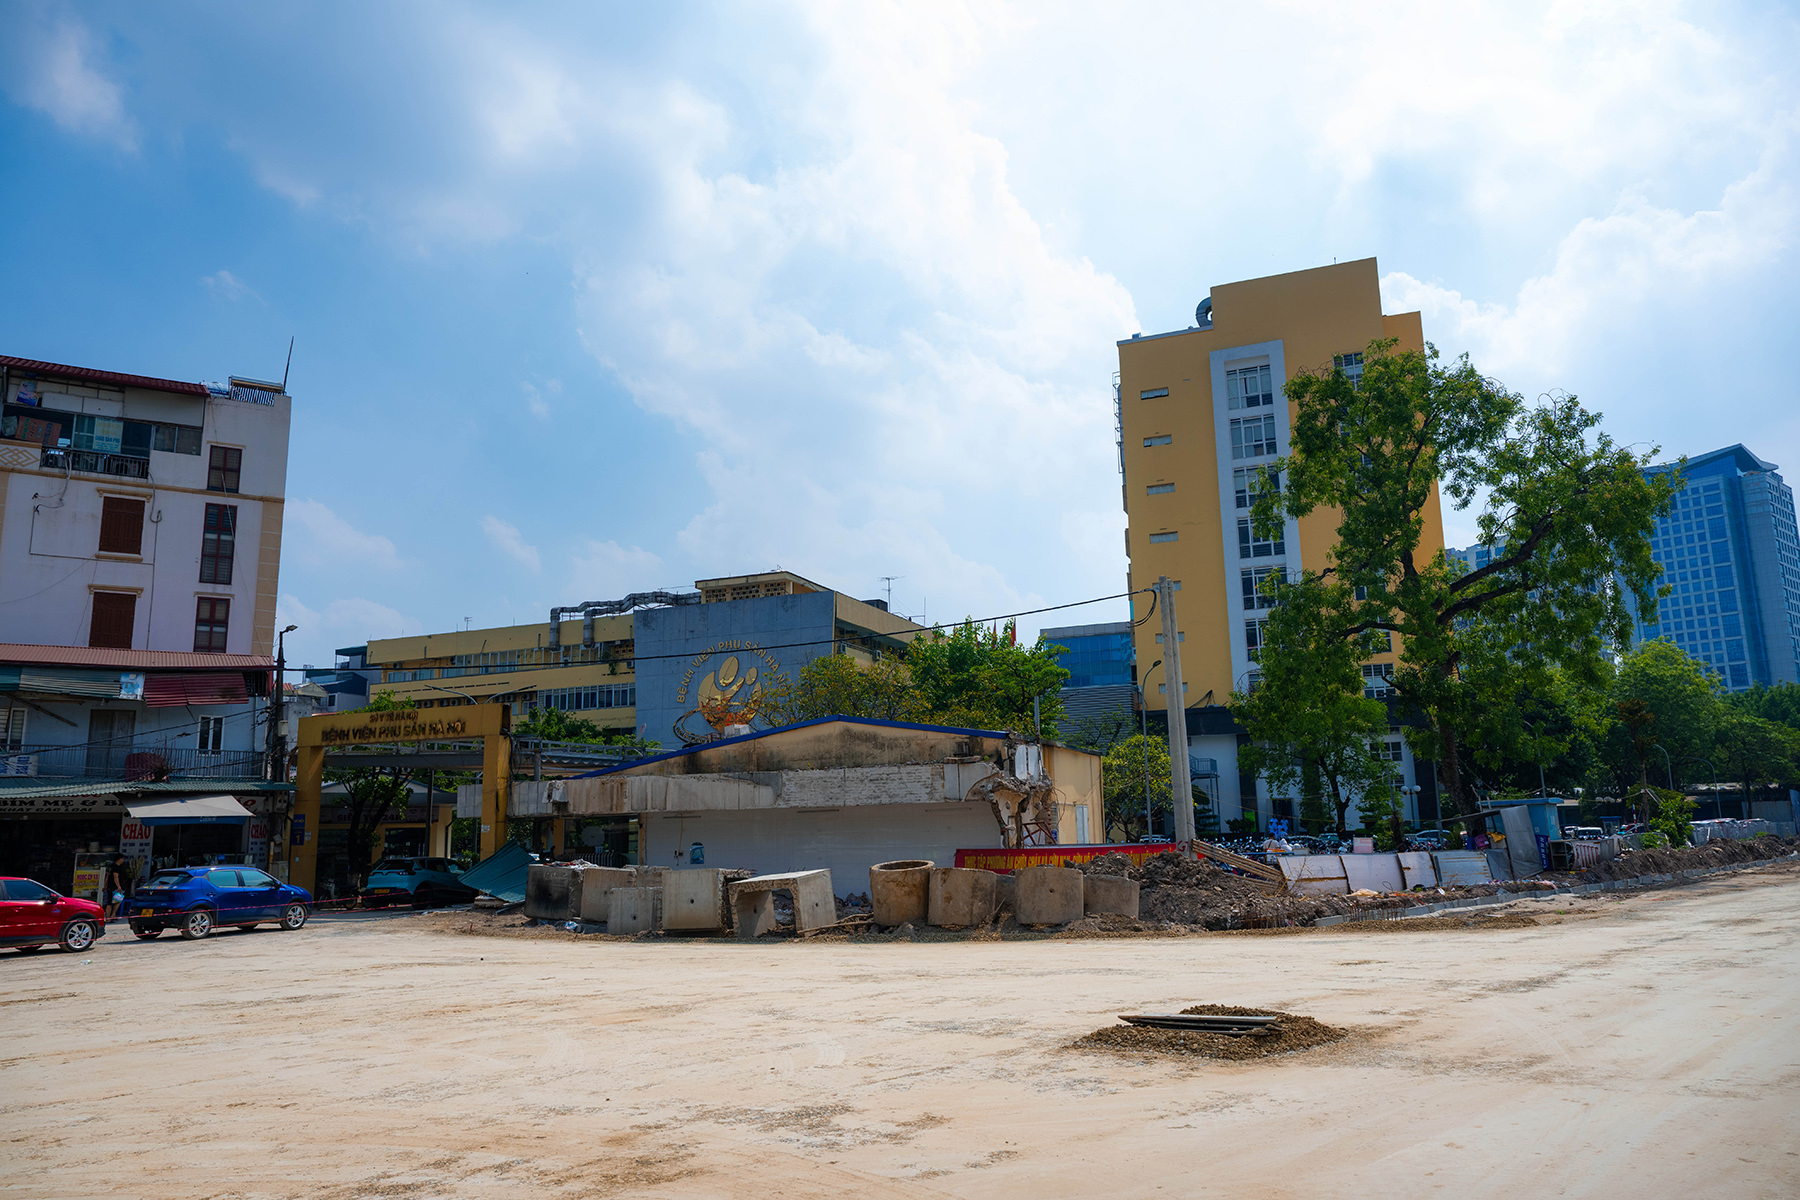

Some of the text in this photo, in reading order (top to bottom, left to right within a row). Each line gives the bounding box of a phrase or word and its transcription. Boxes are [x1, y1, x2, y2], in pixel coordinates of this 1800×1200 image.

[677, 668, 696, 704] BỆNH
[765, 655, 781, 673] HÀ
[321, 727, 350, 742] BỆNH
[352, 724, 377, 741] VIỆN
[428, 719, 445, 735] HÀ
[446, 718, 466, 735] NỘI
[80, 799, 98, 807] &
